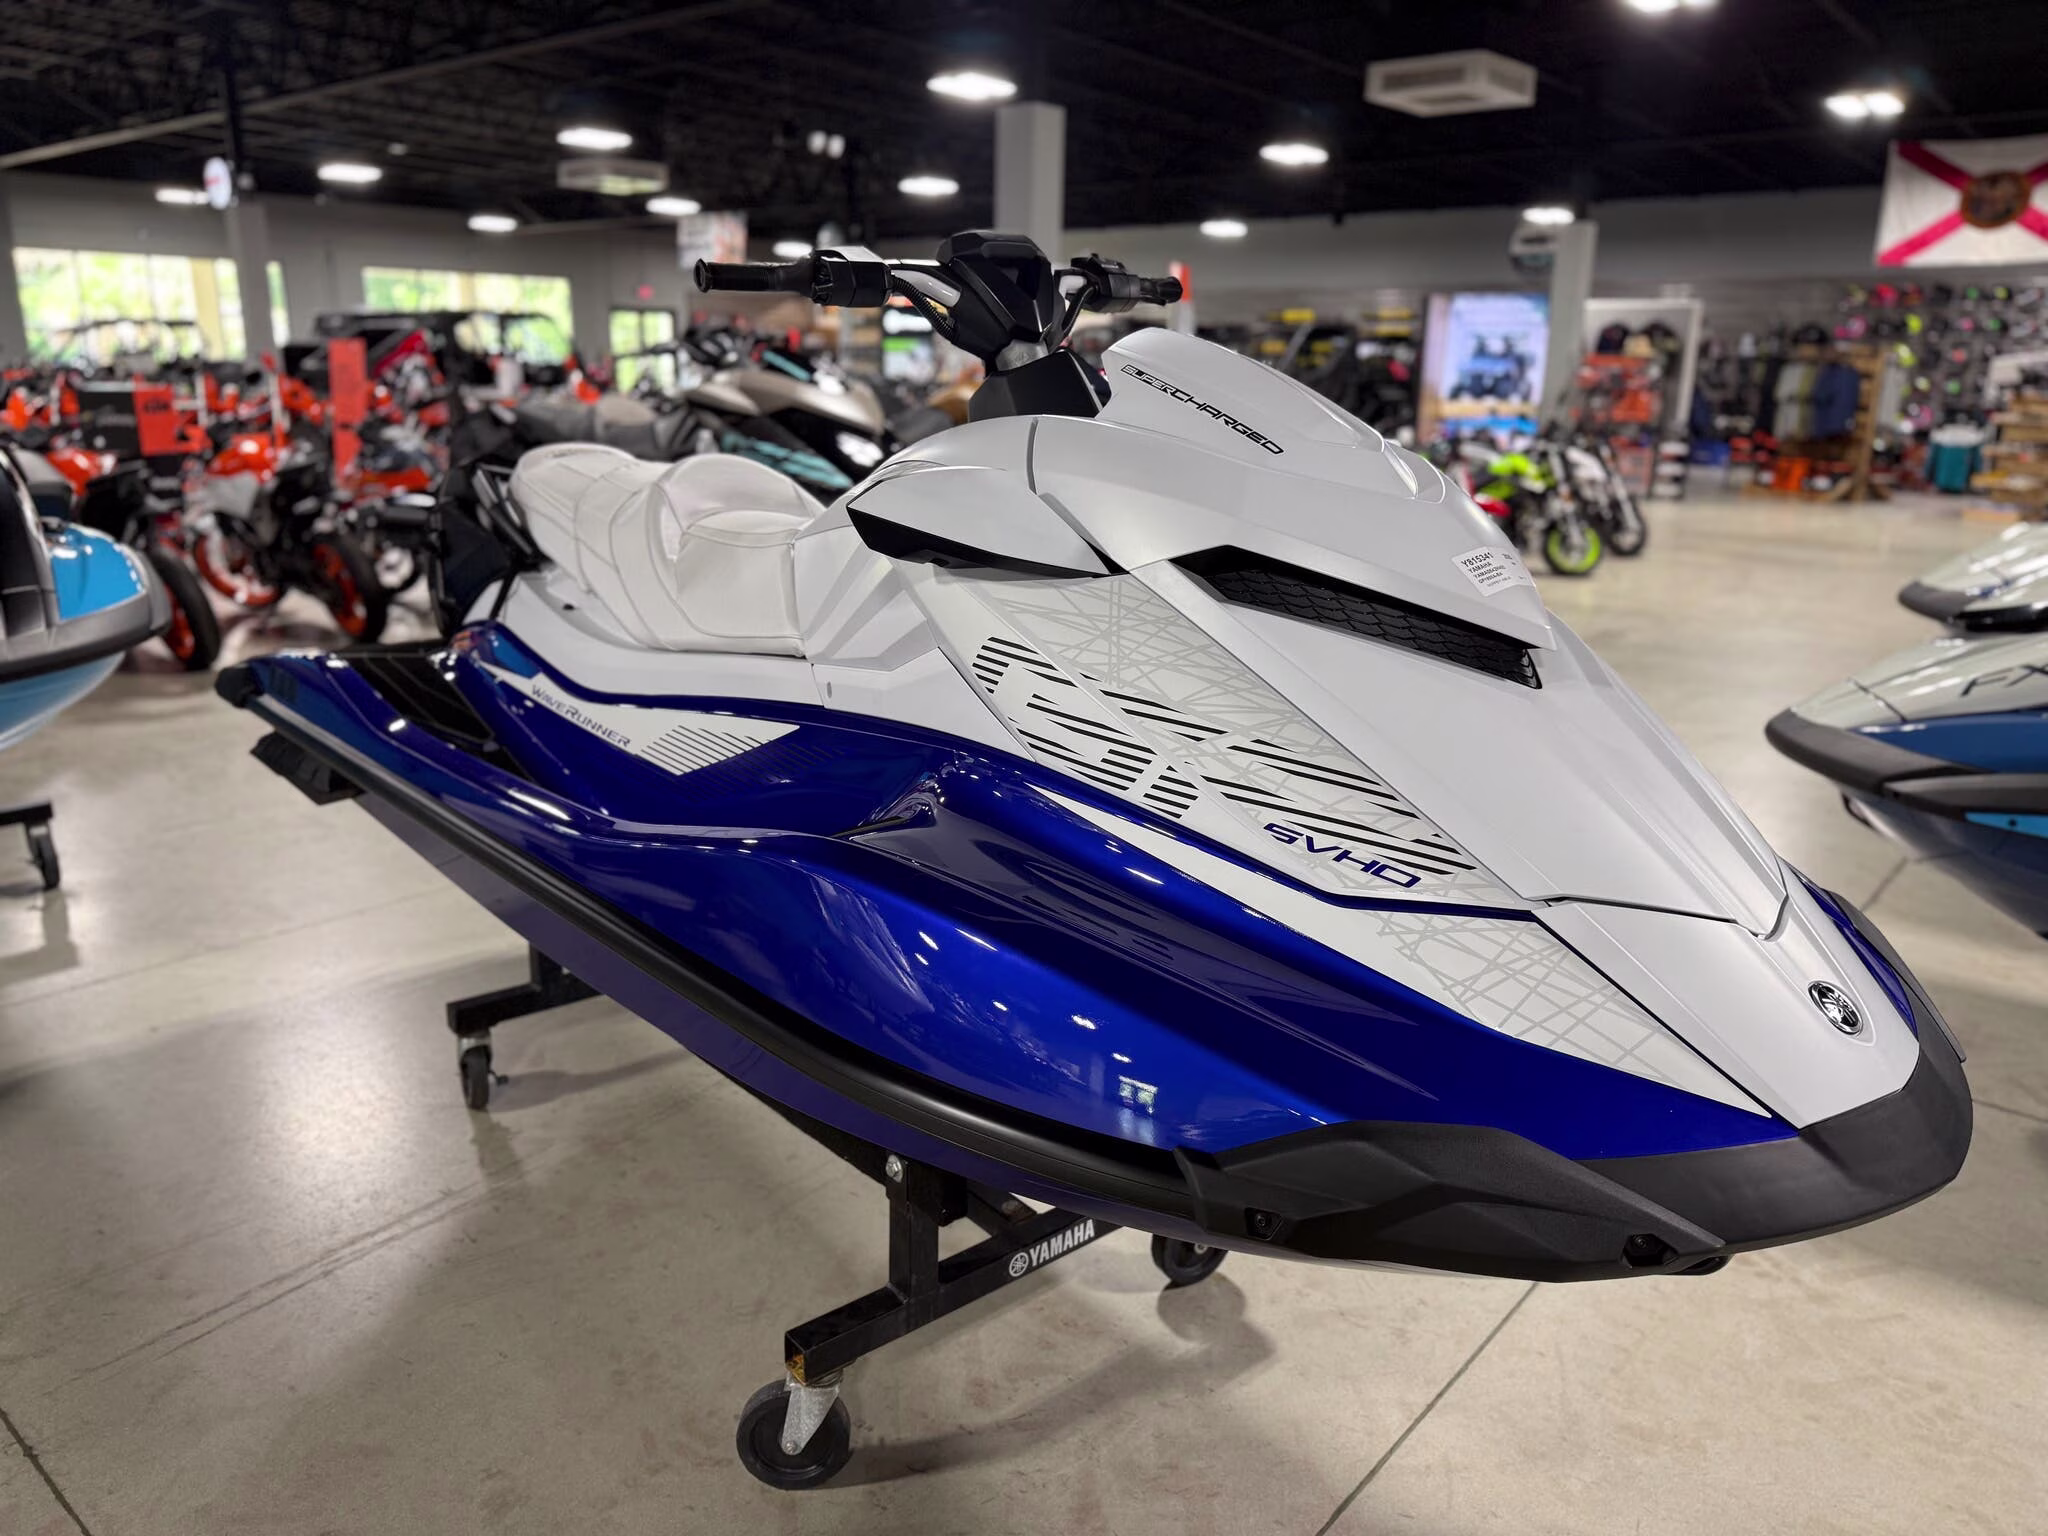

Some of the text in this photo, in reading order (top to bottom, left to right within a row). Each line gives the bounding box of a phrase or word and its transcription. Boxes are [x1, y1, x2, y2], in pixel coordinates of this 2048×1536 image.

[1121, 364, 1284, 455] SUPERCHARGED
[1461, 552, 1494, 568] Y815341
[1468, 561, 1493, 574] YAMAHA
[1264, 822, 1422, 888] SVHO
[1029, 1219, 1095, 1267] YAMAHA
